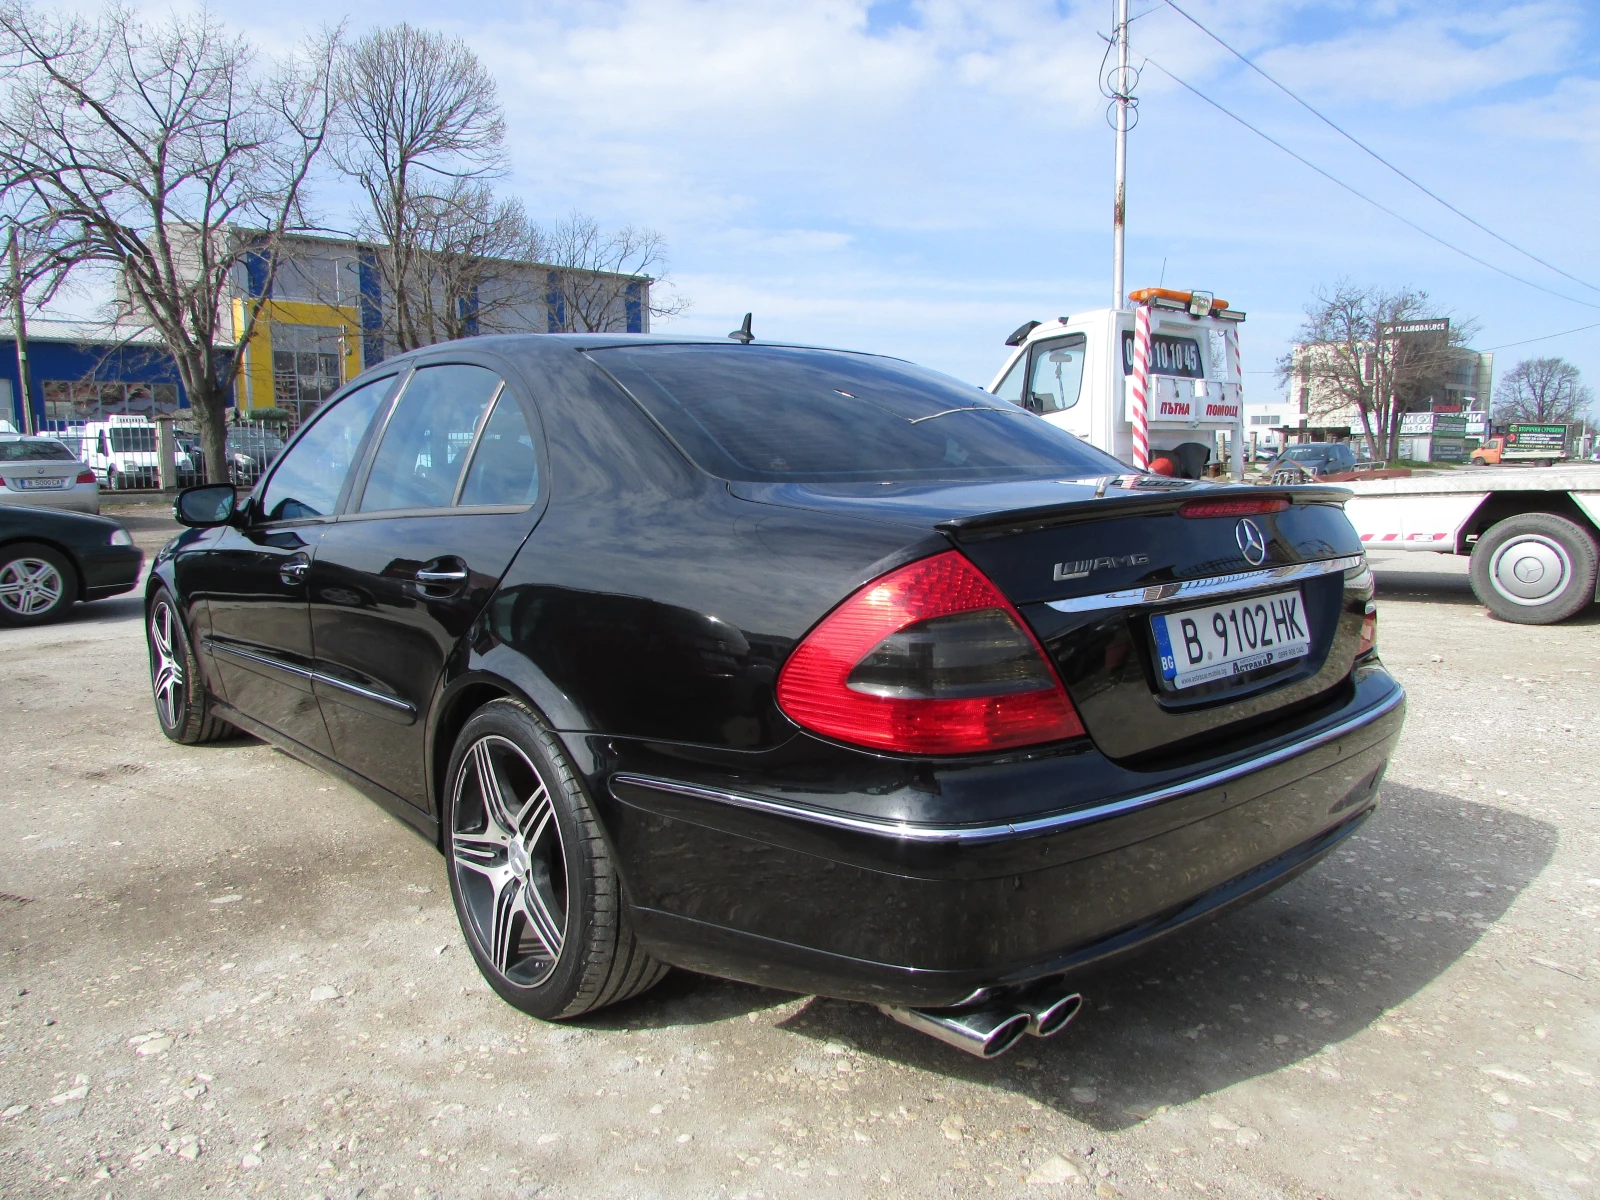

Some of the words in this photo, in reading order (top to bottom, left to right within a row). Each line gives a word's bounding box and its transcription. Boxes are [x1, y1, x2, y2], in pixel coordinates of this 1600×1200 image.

[1154, 341, 1168, 368] 10
[1169, 343, 1183, 370] 10
[1184, 344, 1197, 371] 45
[1160, 401, 1190, 416] ПЪТНА
[1206, 404, 1238, 418] ПОМОЩ
[1180, 618, 1203, 665] B
[1161, 656, 1174, 671] BG
